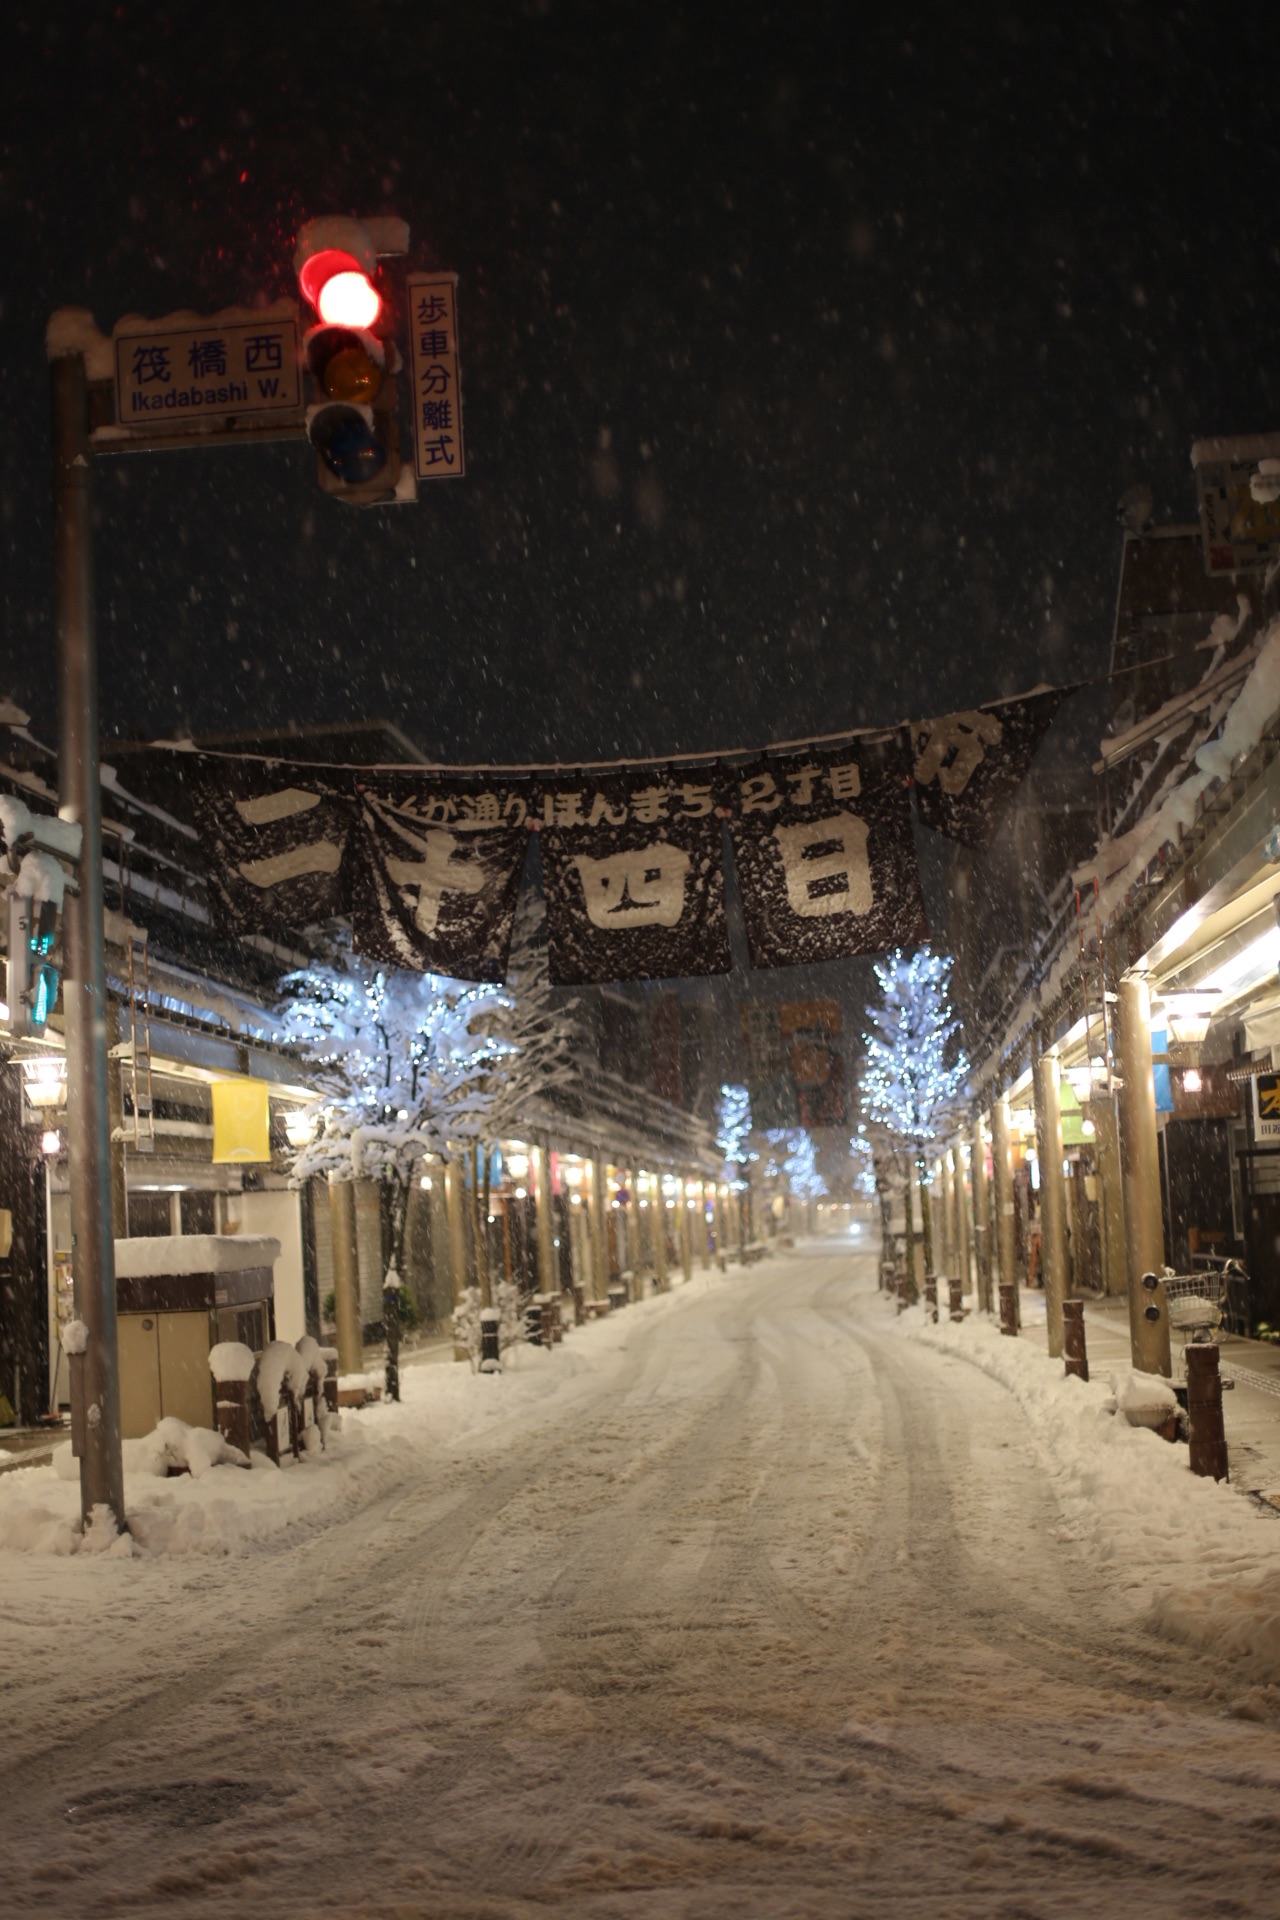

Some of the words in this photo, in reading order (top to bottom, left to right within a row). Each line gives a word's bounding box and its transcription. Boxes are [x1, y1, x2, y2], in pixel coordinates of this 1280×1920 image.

[132, 335, 283, 384] 筏橋西
[418, 295, 454, 465] 歩車分離式
[132, 381, 248, 411] Ikadabashi
[258, 378, 287, 398] W.
